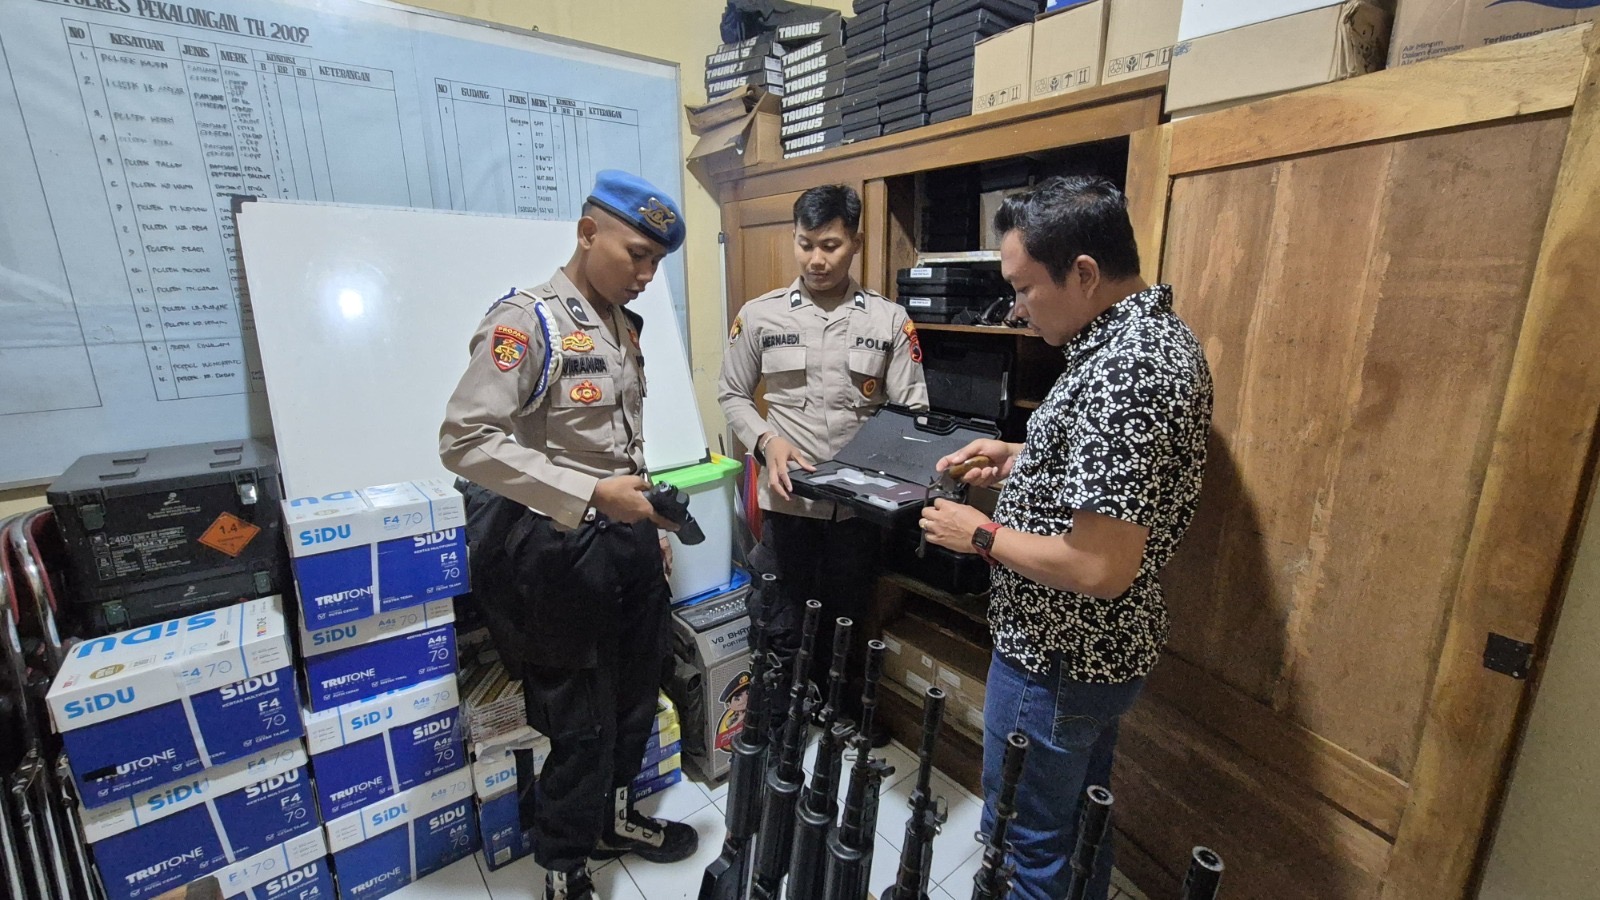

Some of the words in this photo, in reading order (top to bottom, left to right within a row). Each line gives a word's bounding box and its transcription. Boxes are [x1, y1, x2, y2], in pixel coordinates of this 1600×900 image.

[137, 0, 239, 33] PEKALONGAN
[270, 22, 310, 43] 2009
[68, 26, 85, 39] NO
[779, 22, 820, 38] TAURUS
[109, 32, 166, 52] KESATUAN
[182, 45, 210, 58] JENIS
[220, 50, 249, 64] MERK
[782, 41, 822, 66] TAURUS
[319, 65, 370, 82] KETERANGAN
[785, 56, 827, 78] TAURUS
[437, 84, 448, 94] NO
[709, 77, 747, 93] TAURUS
[786, 71, 828, 94] TAURUS
[508, 95, 527, 104] JENIS
[531, 98, 548, 108] MERK
[782, 87, 824, 108] TAURUS
[589, 107, 622, 119] KETERANGAN
[783, 104, 824, 123] TAURUS
[782, 117, 824, 136] TAURUS
[786, 133, 826, 150] TAURUS
[498, 327, 528, 340] PROPAM
[384, 515, 400, 526] F4
[404, 512, 424, 526] 70
[220, 523, 238, 535] 1.4
[299, 524, 352, 546] SiDU
[441, 551, 458, 562] F4
[442, 567, 460, 580] 70
[378, 618, 396, 628] A4s
[400, 613, 418, 626] 70
[312, 625, 358, 646] SiDU
[428, 635, 448, 645] A4s
[712, 636, 724, 645] V8
[429, 648, 449, 662] 70
[205, 660, 232, 678] 70
[321, 668, 376, 689] TRUTONE
[64, 686, 136, 719] SiDU
[258, 697, 280, 712] F4
[413, 695, 430, 706] A4s
[433, 690, 451, 704] 70
[263, 714, 286, 730] 70
[413, 717, 451, 740] SiDU
[434, 737, 452, 748] A4s
[248, 757, 266, 770] F4
[272, 749, 294, 766] 70
[435, 749, 454, 764] 70
[330, 776, 383, 802] TRUTONE
[281, 793, 301, 808] F4
[284, 808, 306, 824] 70
[429, 805, 466, 830] SiDU
[450, 824, 468, 836] A4s
[451, 835, 470, 850] 70
[125, 846, 204, 885] TRUTONE
[251, 858, 276, 876] 70
[266, 863, 318, 896] SiDU
[351, 867, 401, 896] TRUTONE
[299, 886, 319, 900] F4
